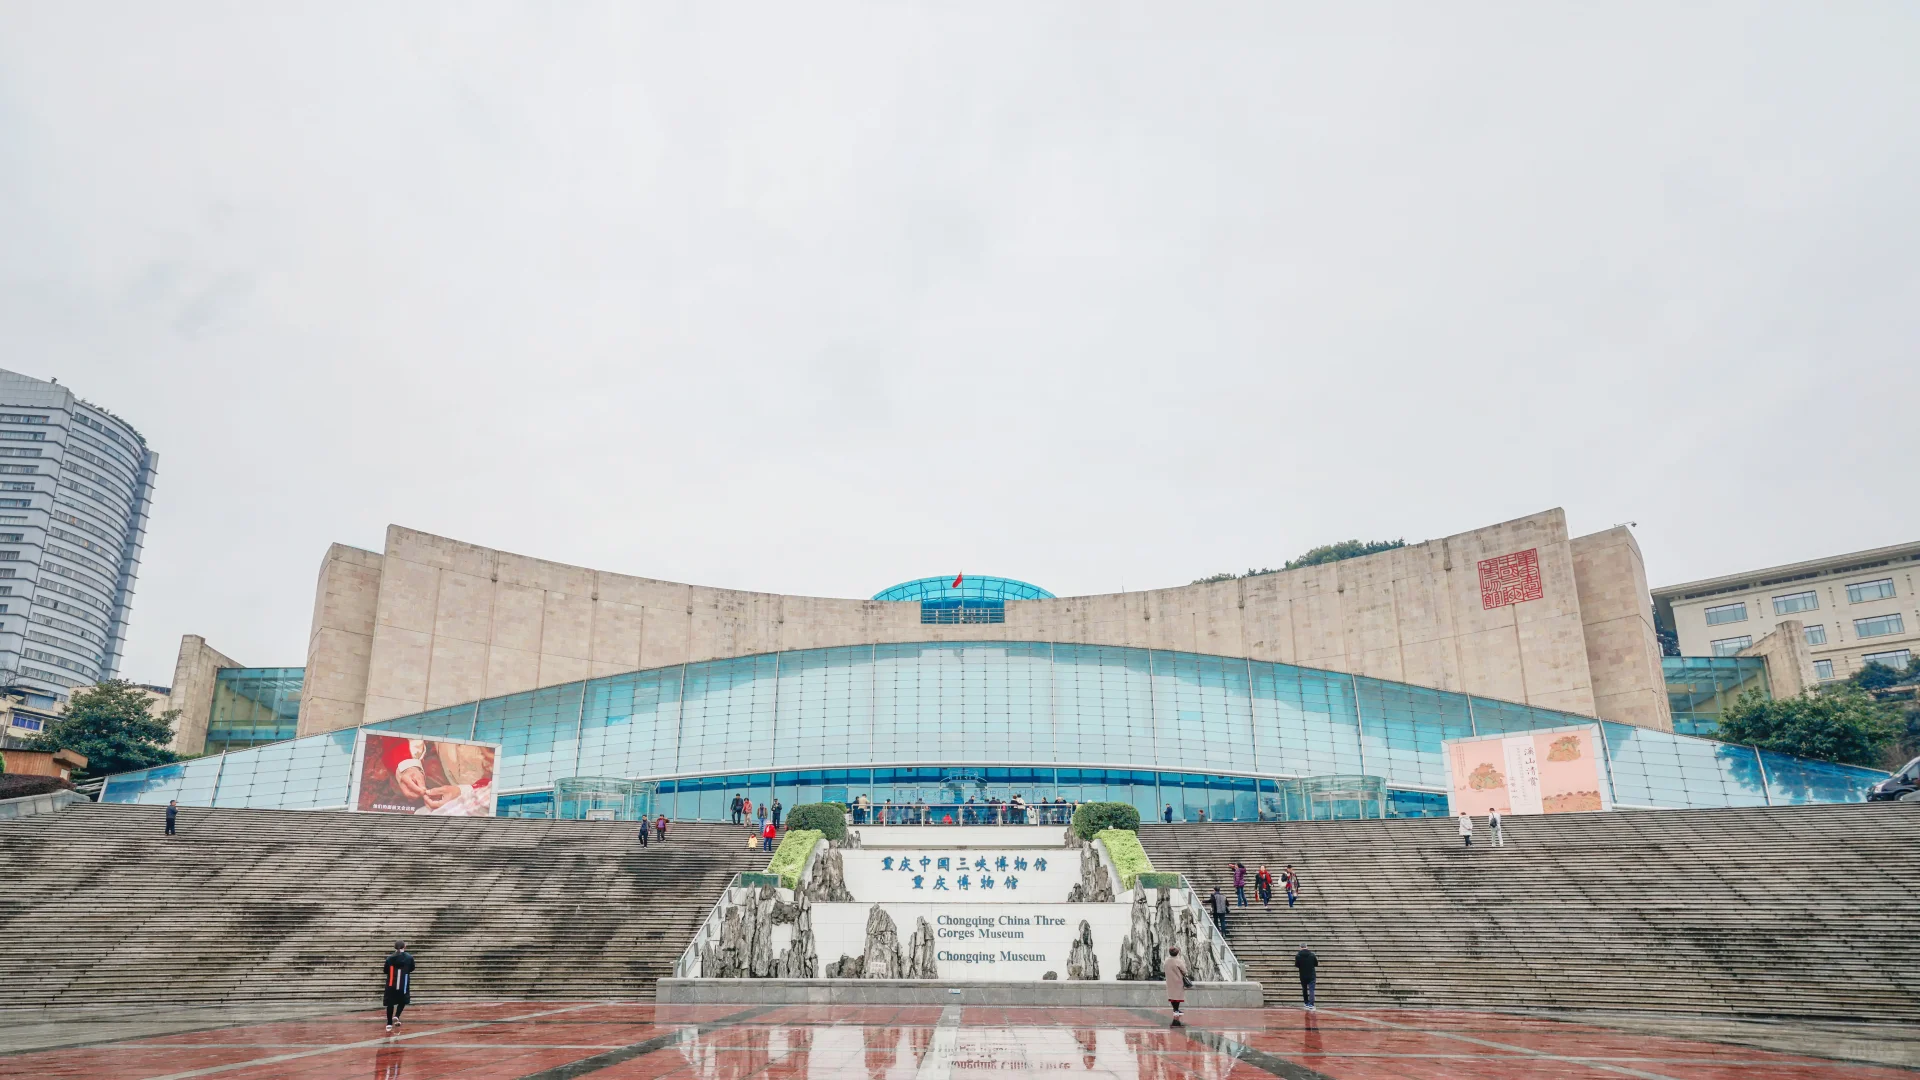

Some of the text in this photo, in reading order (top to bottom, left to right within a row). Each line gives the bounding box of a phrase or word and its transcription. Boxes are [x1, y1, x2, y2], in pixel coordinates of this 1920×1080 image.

[881, 856, 1048, 872] 重庆中国三峡博物馆
[911, 875, 1019, 890] 重庆博物馆
[937, 915, 1066, 927] Chongqing China Three
[937, 928, 1024, 940] Gorges Museum
[937, 951, 1046, 963] Chongqing Museum
